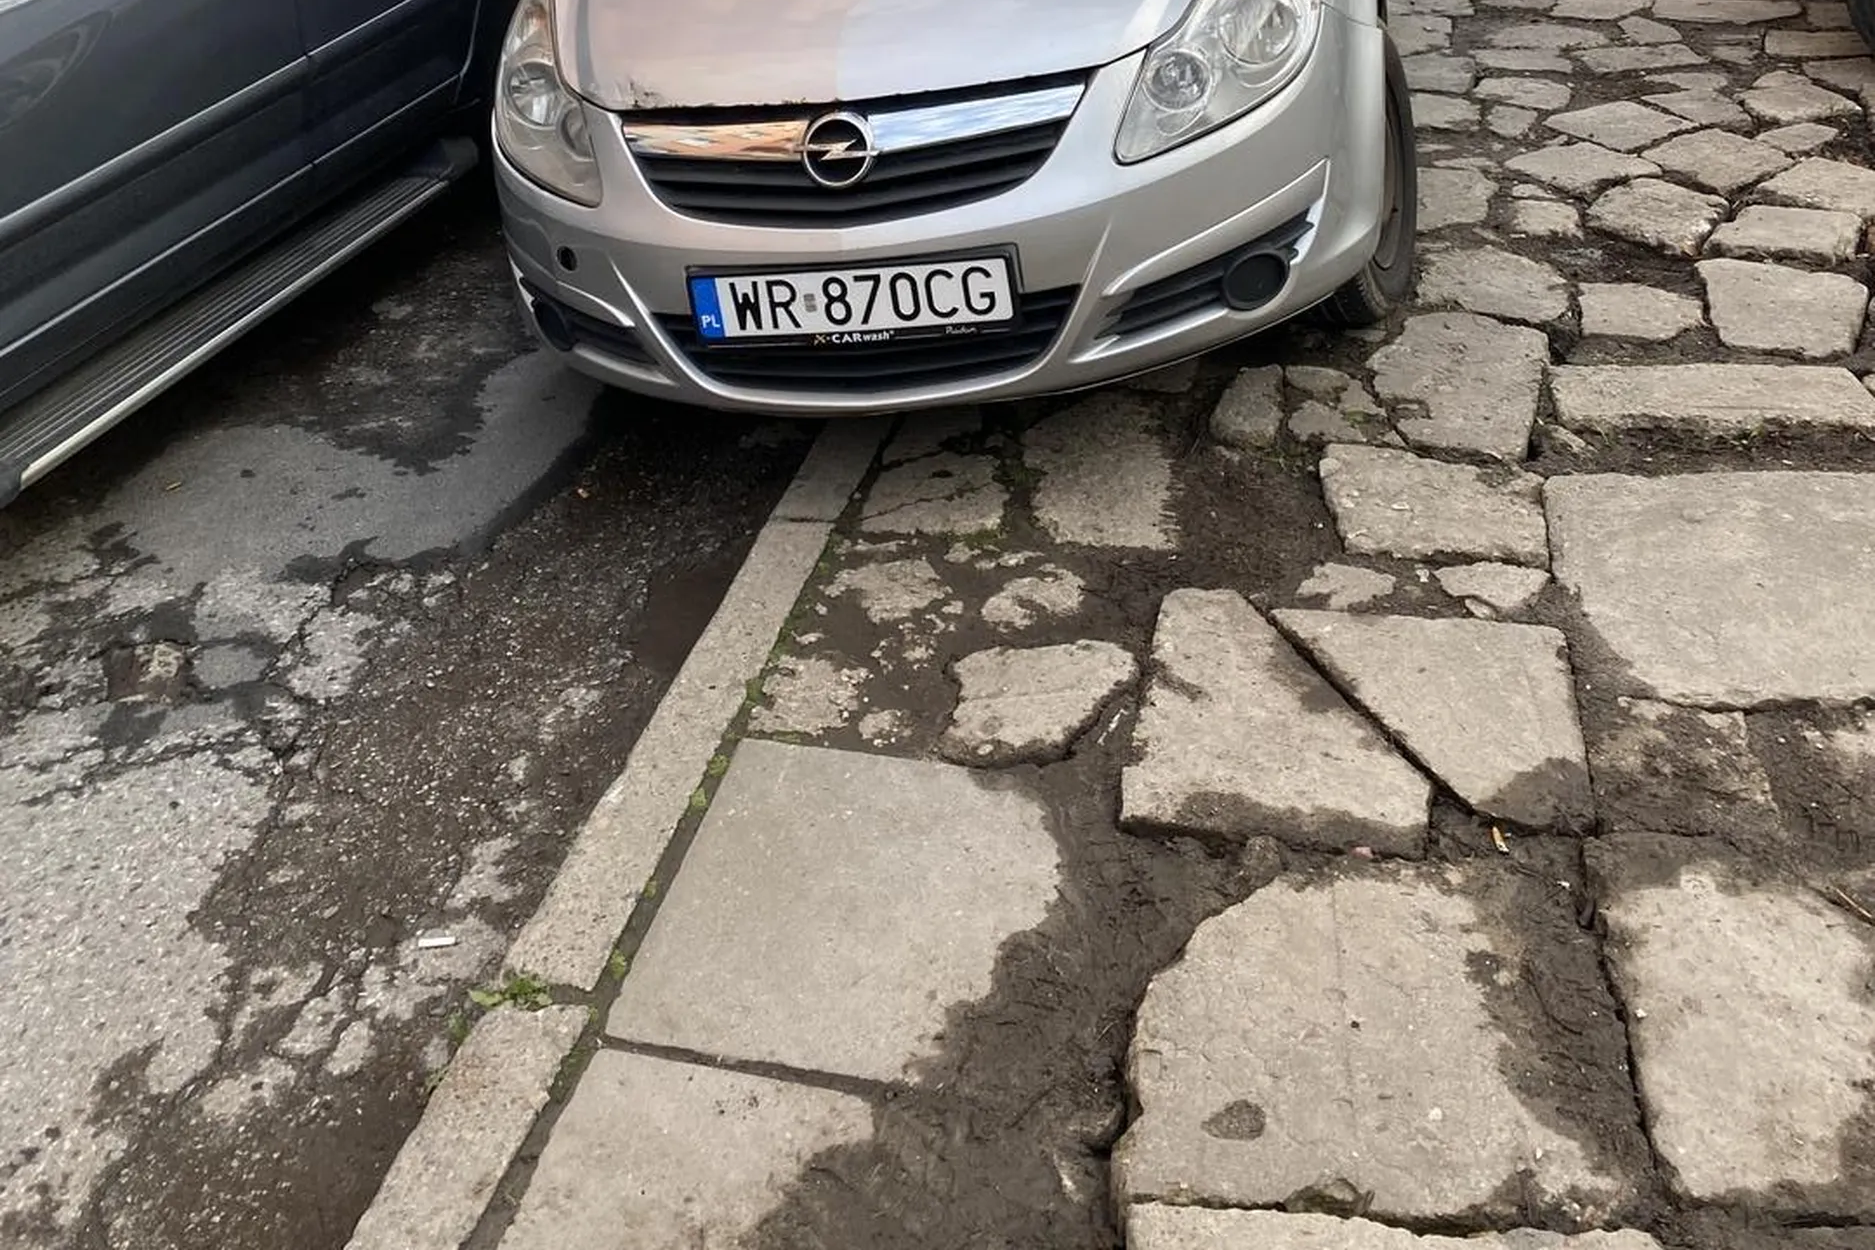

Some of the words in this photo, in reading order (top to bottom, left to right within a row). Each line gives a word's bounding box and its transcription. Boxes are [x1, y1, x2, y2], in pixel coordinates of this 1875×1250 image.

[728, 279, 801, 331] WR
[821, 266, 996, 327] 870CG
[701, 314, 720, 329] PL
